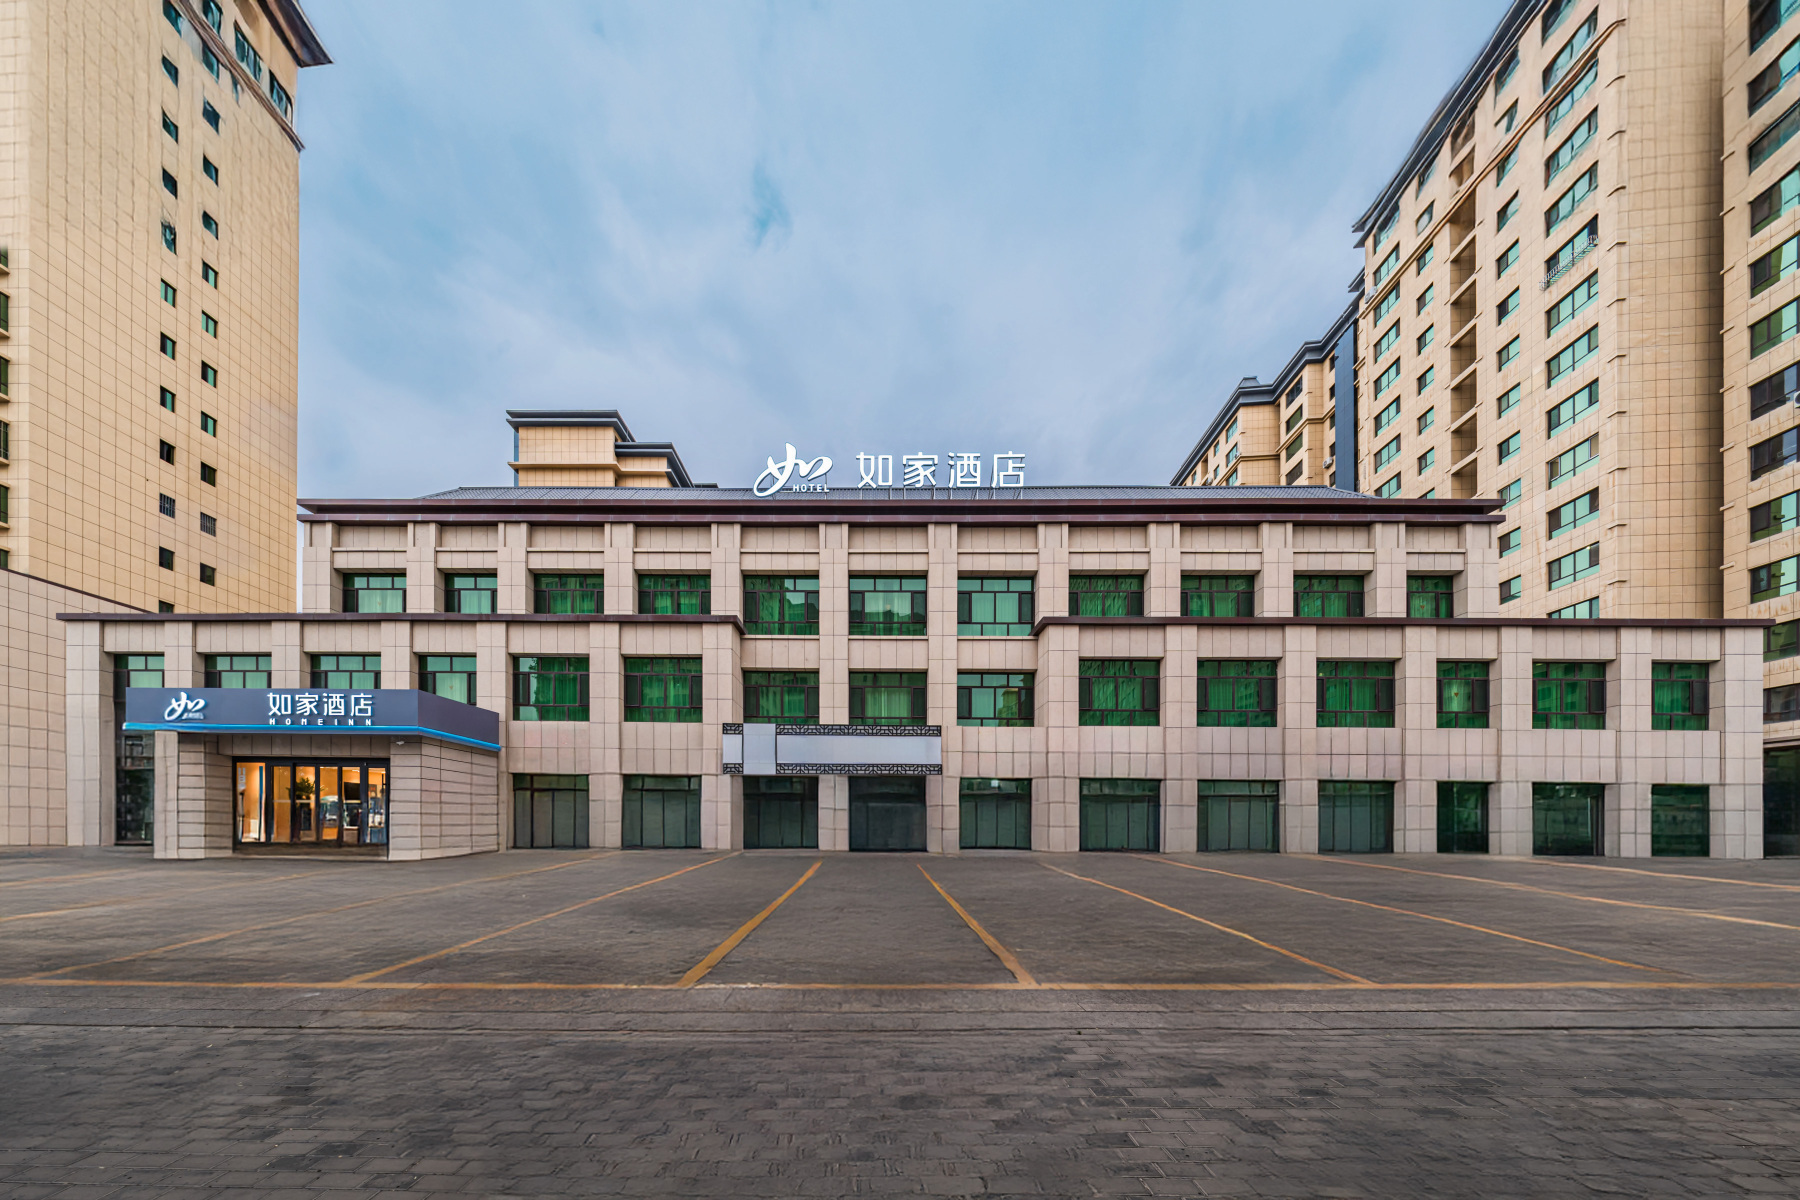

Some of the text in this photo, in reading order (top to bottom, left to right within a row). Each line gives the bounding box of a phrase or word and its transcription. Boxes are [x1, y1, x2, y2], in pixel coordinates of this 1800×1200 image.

[856, 451, 1026, 488] 如家酒店
[793, 484, 829, 492] HOTEL
[267, 692, 373, 716] 如家酒店
